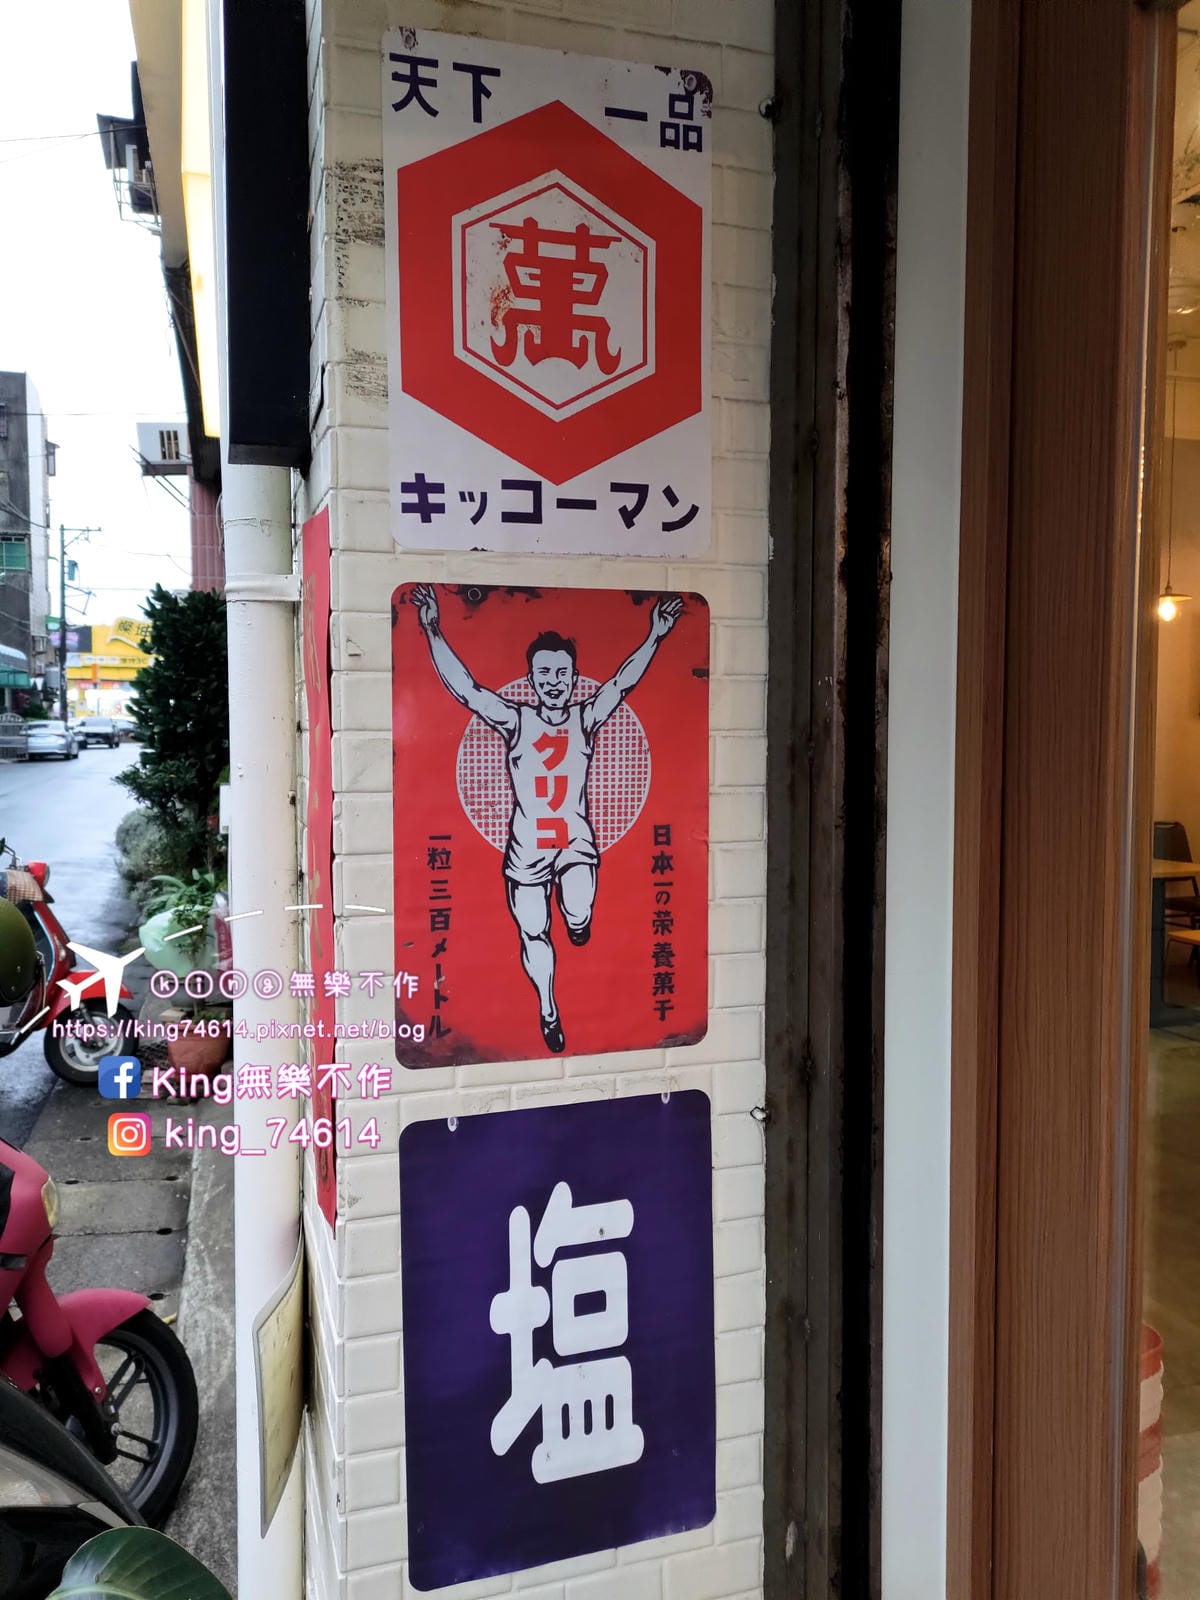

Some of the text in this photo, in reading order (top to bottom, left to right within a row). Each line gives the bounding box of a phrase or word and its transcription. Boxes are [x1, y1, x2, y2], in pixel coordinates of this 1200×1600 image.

[389, 52, 703, 152] 天下 一品
[489, 216, 622, 375] 萬
[400, 472, 700, 532] キッコーマン
[532, 729, 569, 849] グリコ
[427, 834, 452, 1039] 一粒三百メートル
[489, 1181, 645, 1484] 塩
